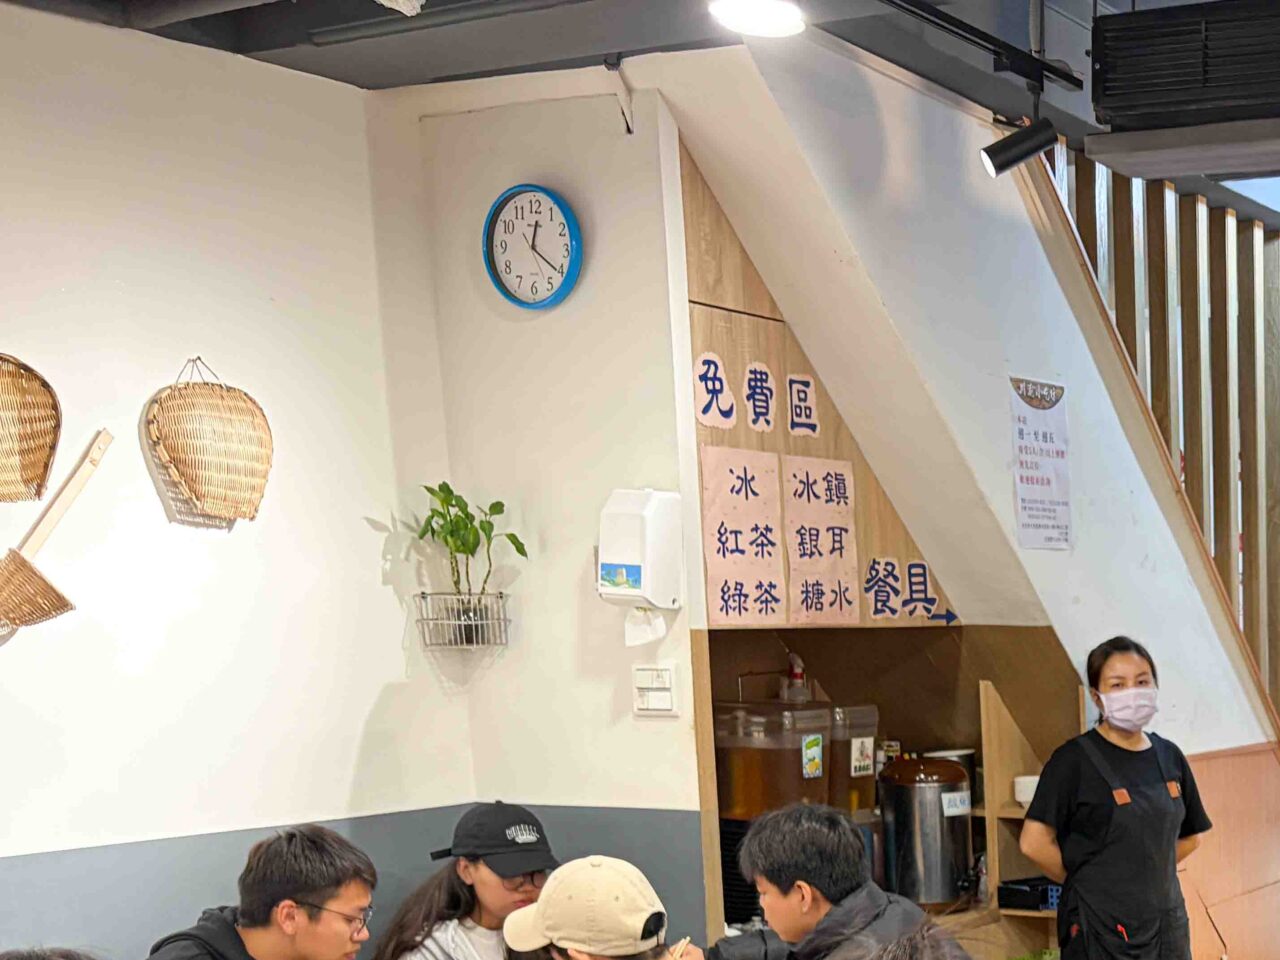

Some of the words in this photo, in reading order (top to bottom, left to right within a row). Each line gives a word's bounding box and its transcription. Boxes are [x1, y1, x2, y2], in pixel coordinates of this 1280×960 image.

[514, 205, 525, 221] 11
[529, 199, 542, 215] 12
[549, 206, 554, 222] 1
[503, 219, 515, 235] 10
[559, 221, 566, 237] 2
[500, 239, 508, 255] 9
[562, 243, 570, 259] 3
[504, 260, 512, 275] 8
[557, 263, 565, 278] 4
[516, 275, 523, 289] 7
[530, 281, 538, 296] 6
[546, 276, 554, 292] 5
[698, 359, 818, 433] 免費區
[728, 466, 760, 501] 冰
[792, 471, 849, 506] 冰鎮
[716, 520, 777, 560] 紅茶
[795, 524, 849, 559] 銀耳
[863, 558, 937, 617] 餐具
[719, 579, 781, 617] 綠茶
[800, 579, 853, 613] 糖水
